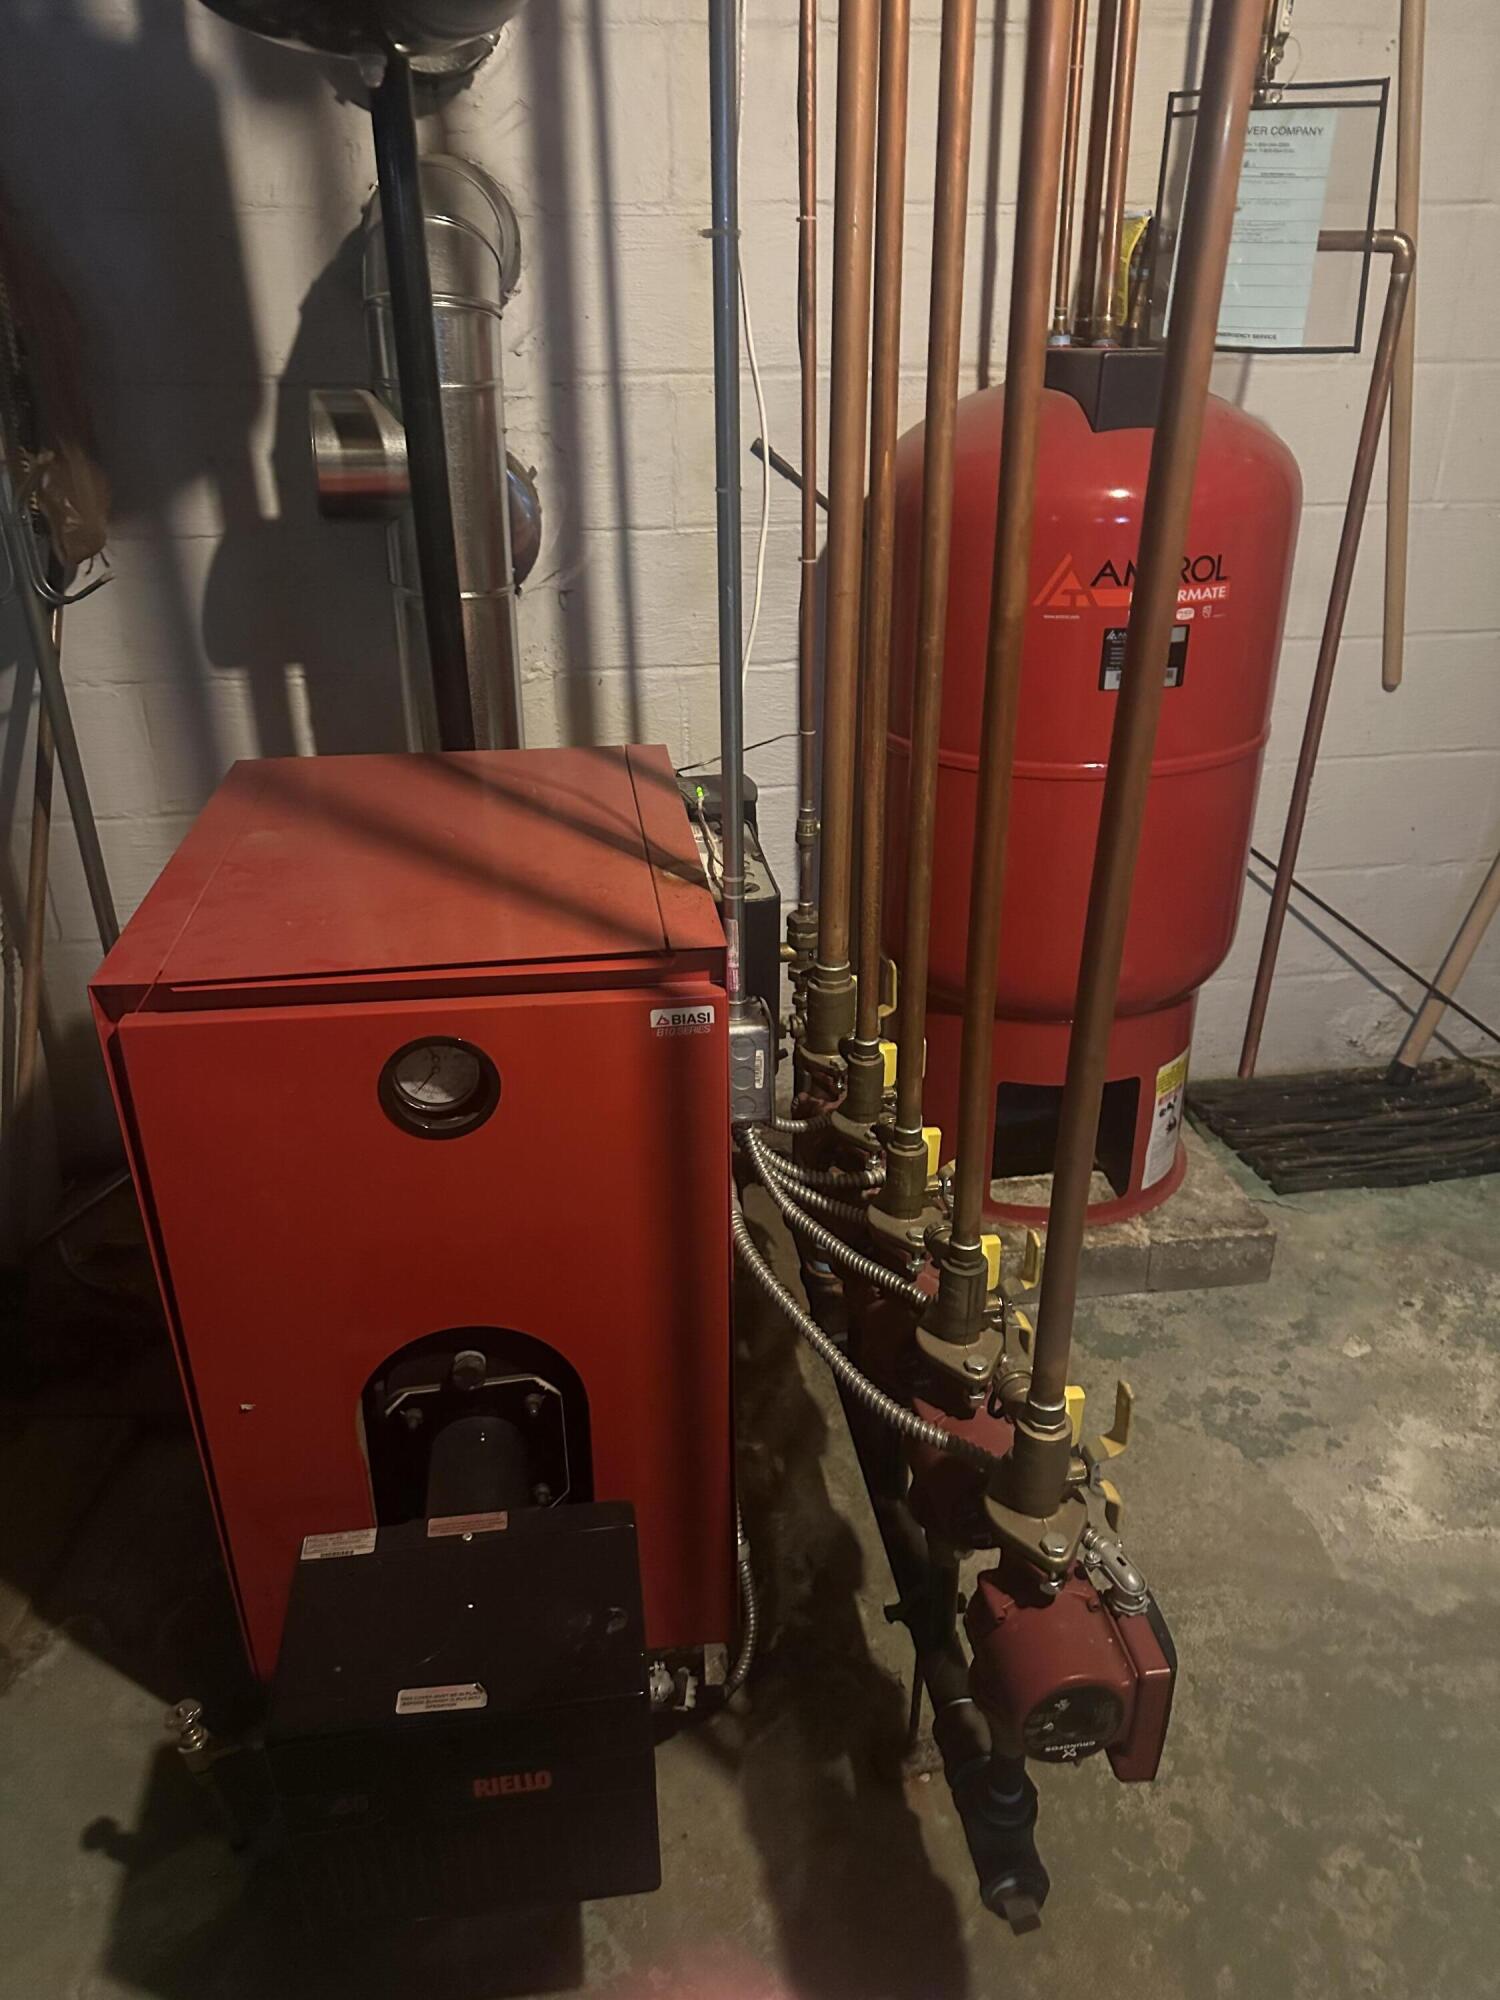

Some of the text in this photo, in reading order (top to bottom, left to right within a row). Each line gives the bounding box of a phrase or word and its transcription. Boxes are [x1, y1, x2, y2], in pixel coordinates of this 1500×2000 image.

[1248, 125, 1324, 135] VER COMPANY
[672, 1012, 710, 1024] BIASI
[1045, 1741, 1095, 1752] GRUNDFOS
[474, 1770, 552, 1798] RIELLO
